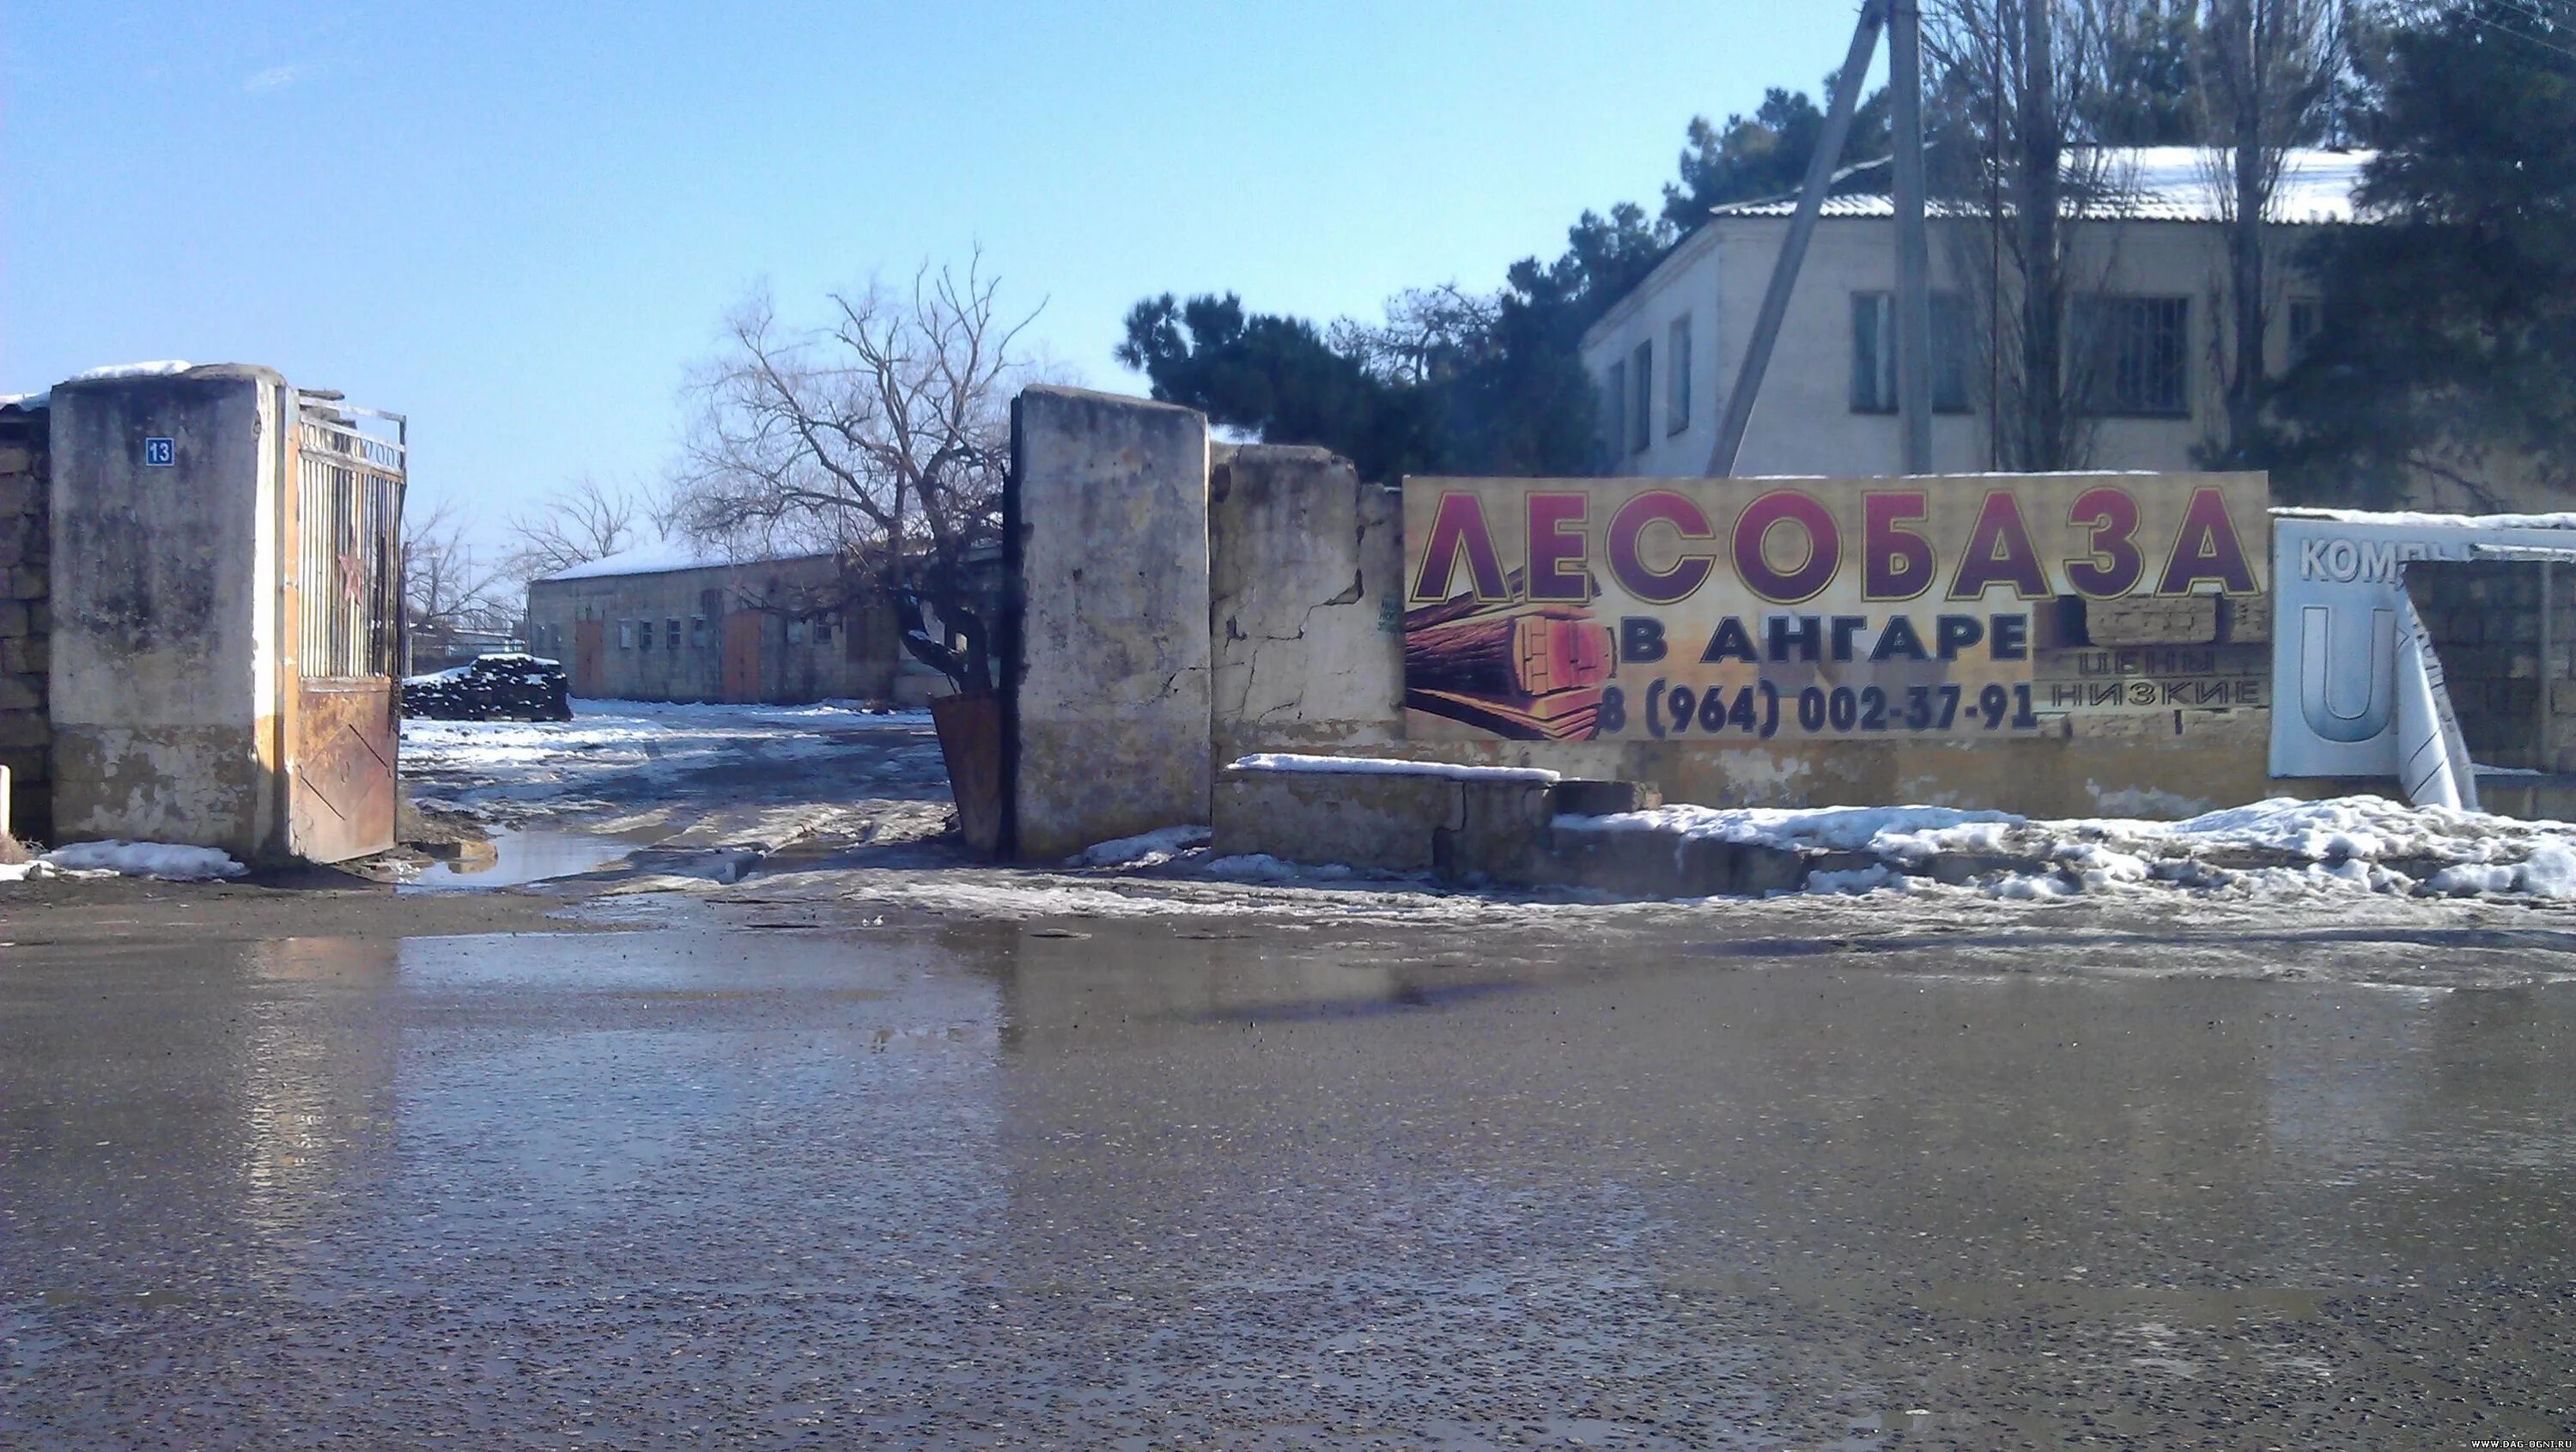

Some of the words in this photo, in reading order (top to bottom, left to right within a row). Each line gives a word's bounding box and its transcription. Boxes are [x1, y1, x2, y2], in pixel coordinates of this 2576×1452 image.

[149, 442, 170, 461] 13
[1410, 485, 2262, 605] ЛЕСОБАЗА
[1620, 615, 1668, 664] В
[1698, 613, 2028, 664] АНГАРЕ
[2078, 650, 2215, 676] ЦЕНЫ
[1601, 684, 1627, 733] 8
[1644, 677, 1780, 740] (964)
[1798, 682, 2038, 733] 002-37-91
[2050, 681, 2260, 708] НИЗКИЕ
